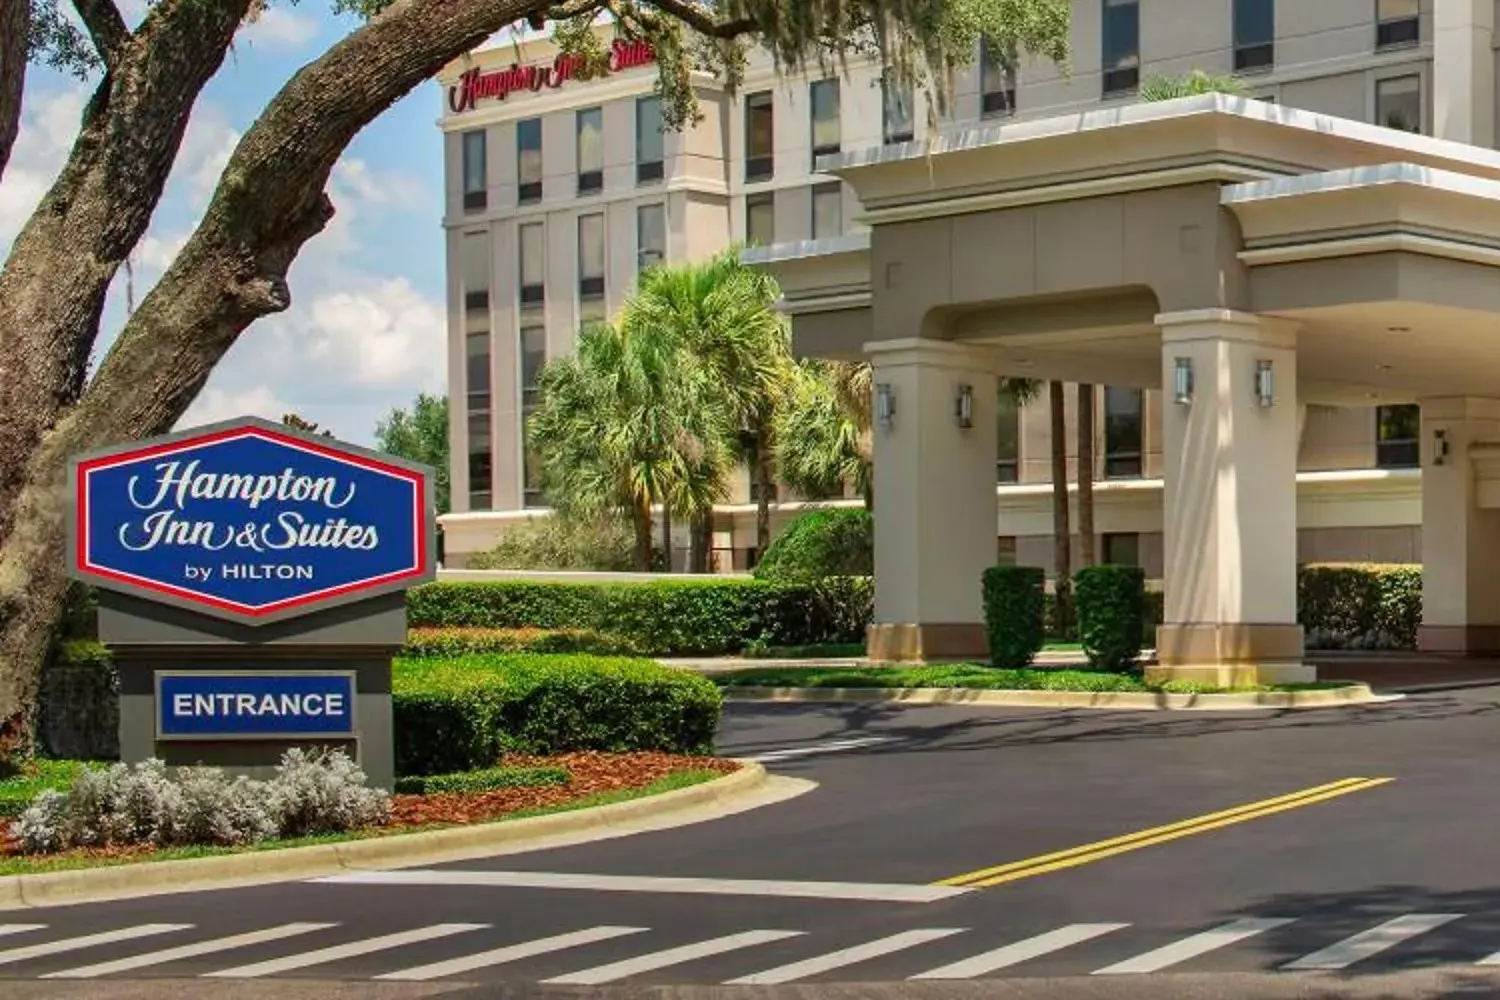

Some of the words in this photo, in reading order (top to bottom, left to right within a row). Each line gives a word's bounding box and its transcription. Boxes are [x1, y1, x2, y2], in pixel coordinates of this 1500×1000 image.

[128, 460, 355, 509] Hampton
[119, 510, 234, 550] Inn
[235, 523, 264, 551] &
[262, 511, 379, 551] Suites
[185, 564, 212, 581] by
[222, 564, 313, 579] HILTON
[173, 693, 343, 716] ENTRANCE
